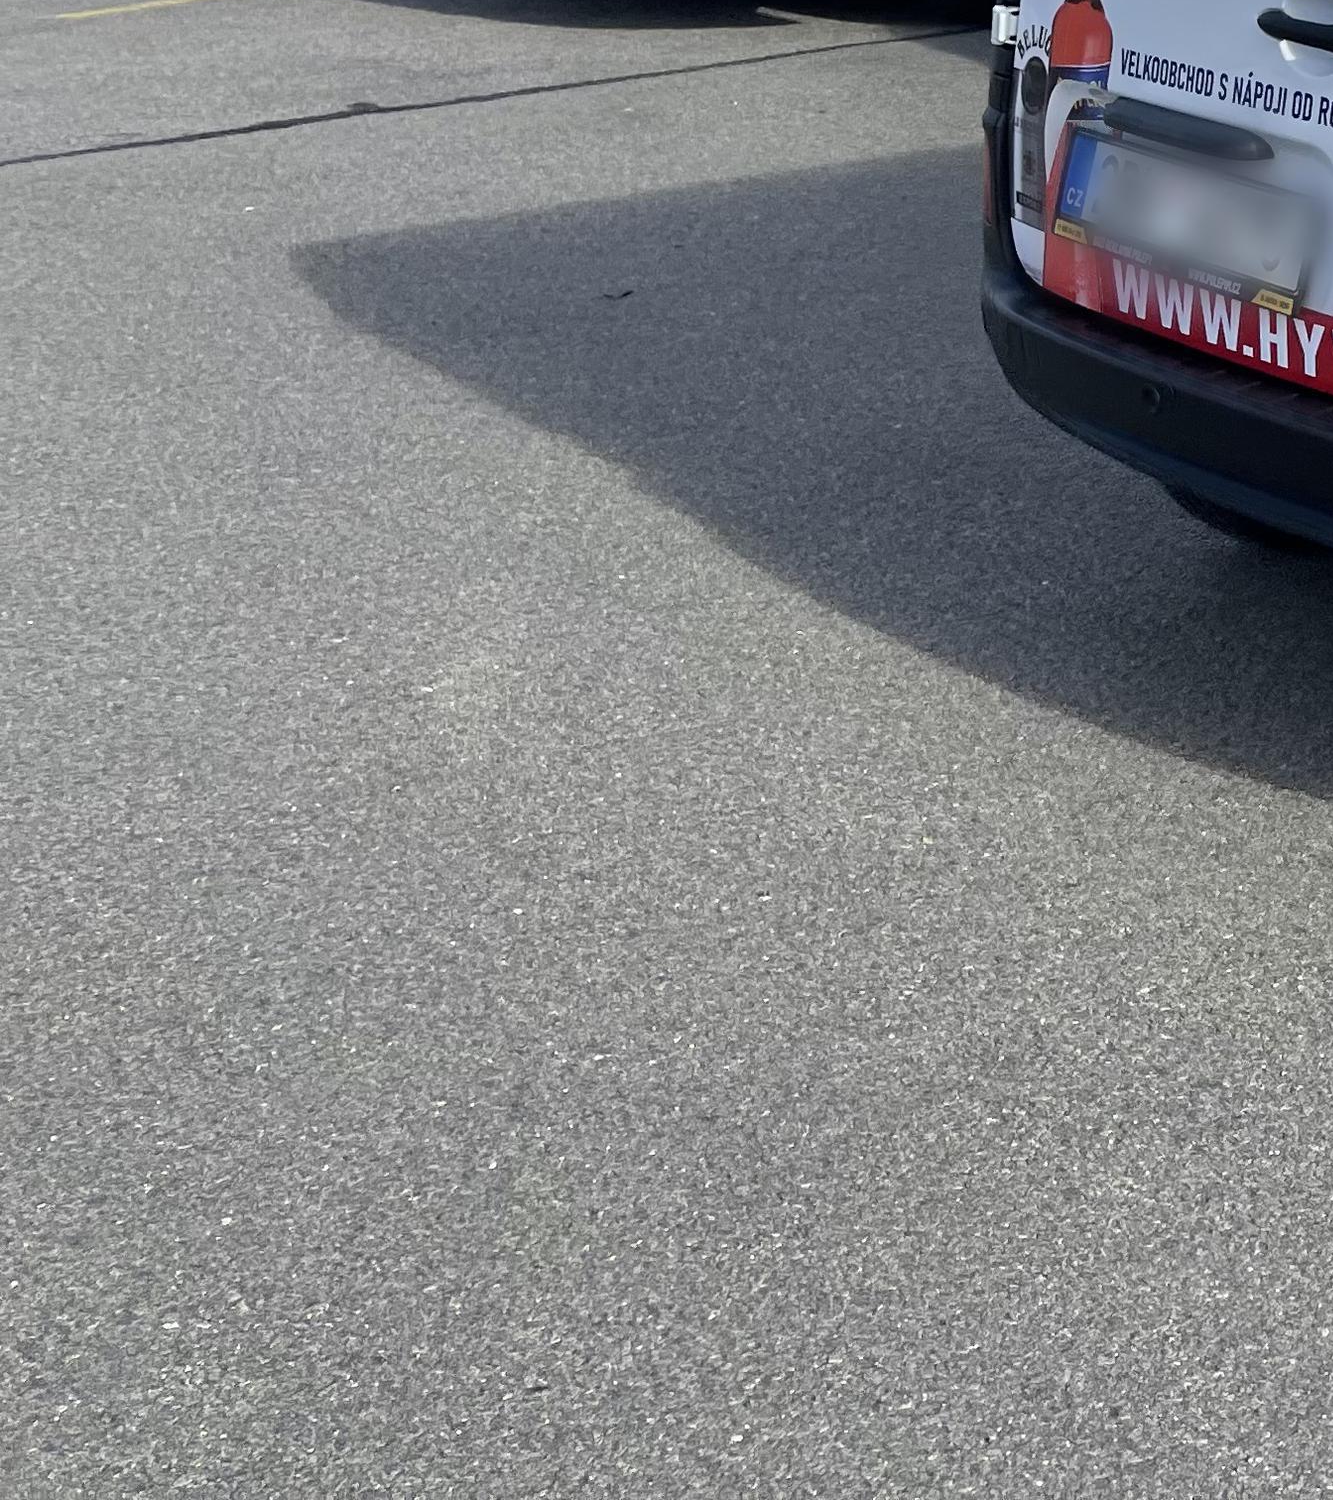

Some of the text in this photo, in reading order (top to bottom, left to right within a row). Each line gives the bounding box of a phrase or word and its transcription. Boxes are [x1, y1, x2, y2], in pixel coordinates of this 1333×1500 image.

[1120, 47, 1213, 97] VELKOOBCHOD
[1218, 73, 1227, 99] S
[1232, 71, 1286, 117] NÁPOJI
[1291, 92, 1313, 121] OD
[1066, 187, 1083, 207] CZ
